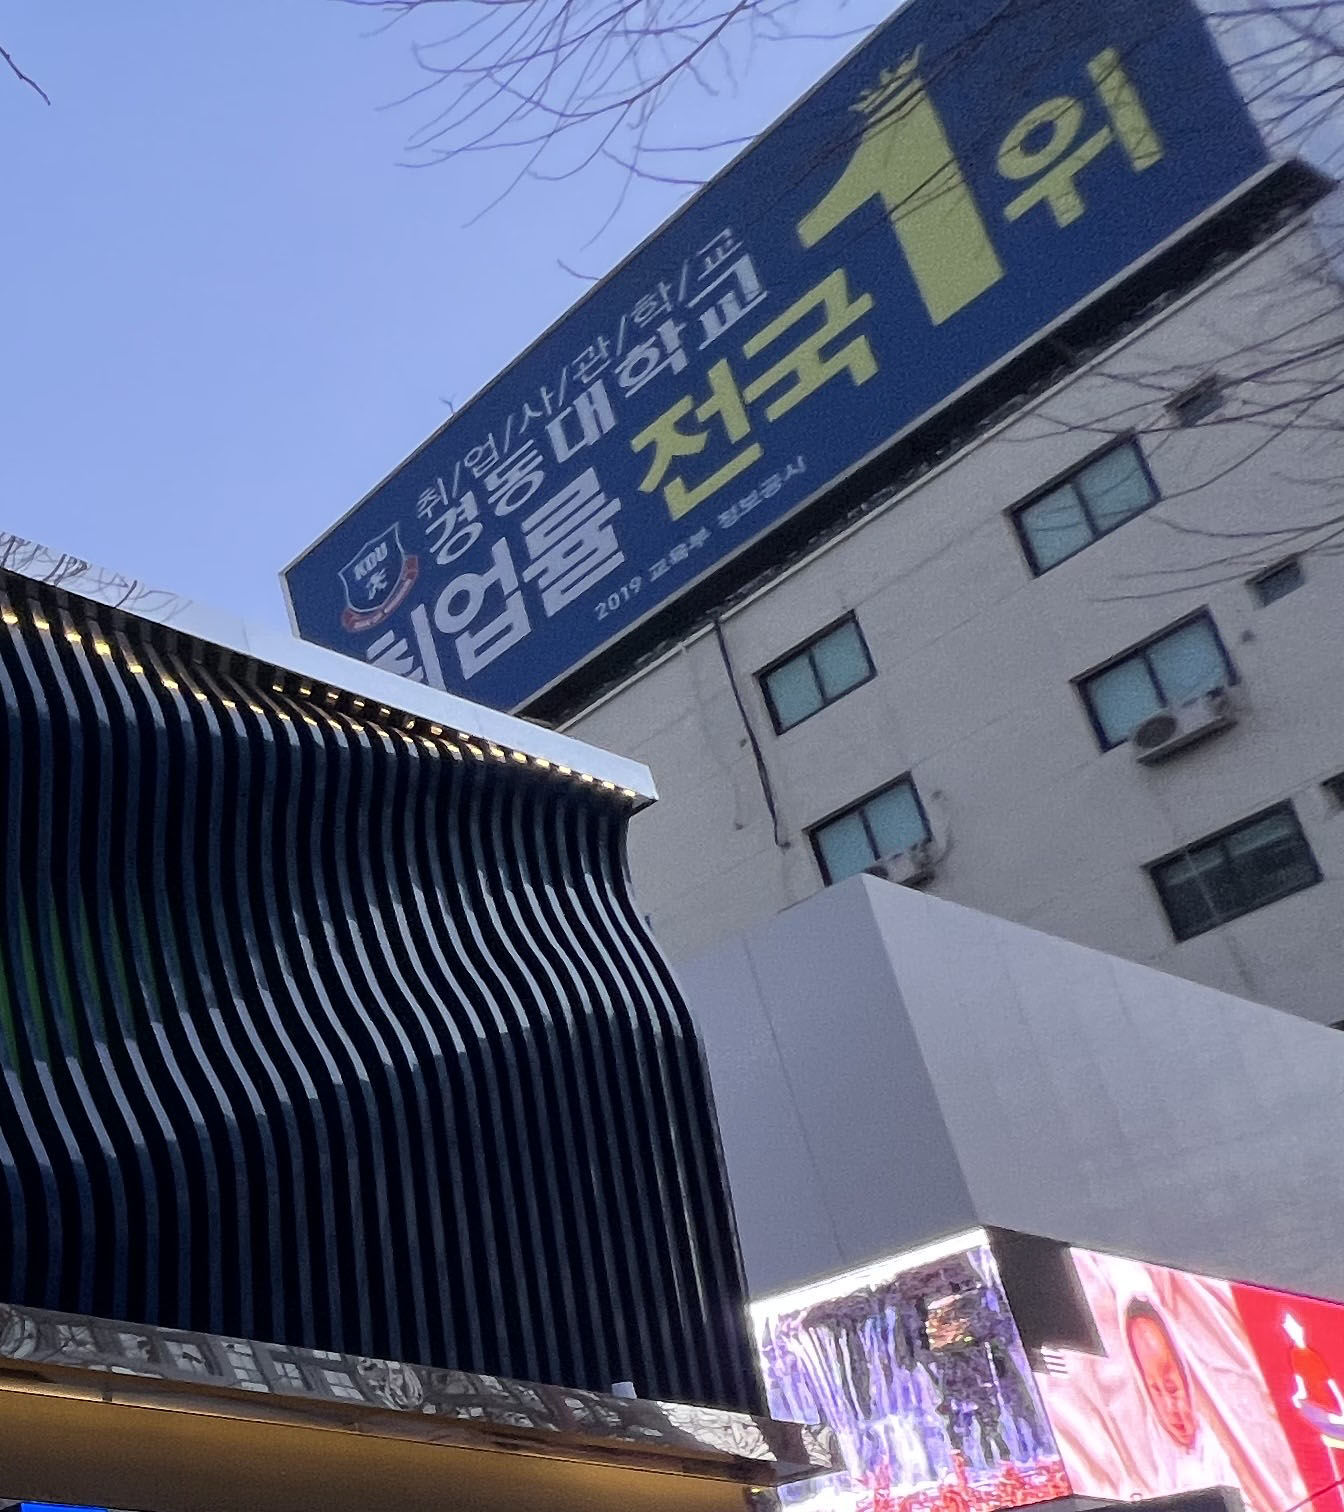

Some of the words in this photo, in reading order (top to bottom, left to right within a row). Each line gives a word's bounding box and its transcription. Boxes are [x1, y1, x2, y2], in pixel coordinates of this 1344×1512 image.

[365, 467, 625, 692] 취업률
[630, 268, 880, 522] 전국
[424, 254, 767, 565] 경동대학교
[354, 541, 388, 580] KDU
[594, 576, 643, 621] 2019
